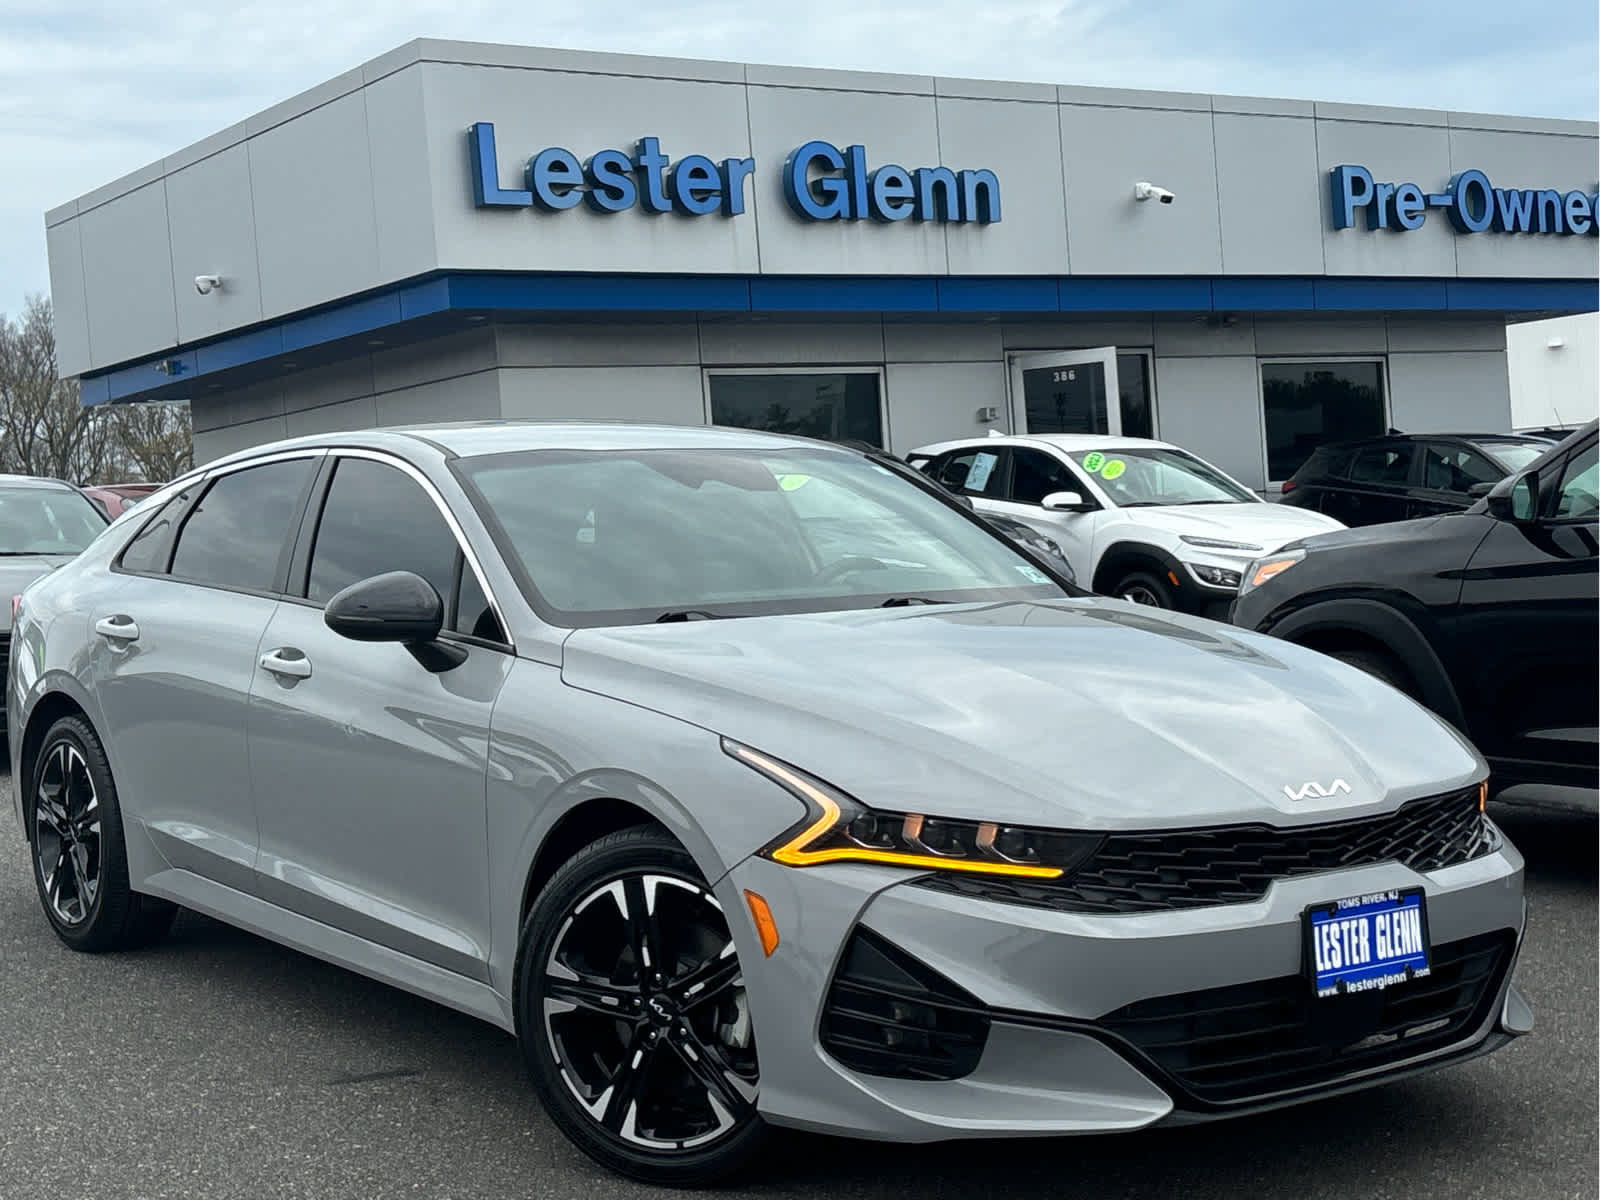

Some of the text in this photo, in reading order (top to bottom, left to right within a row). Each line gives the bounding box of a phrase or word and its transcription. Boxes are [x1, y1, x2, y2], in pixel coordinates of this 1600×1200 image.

[468, 122, 1002, 225] Lester Glenn
[1338, 898, 1361, 910] TOMS
[1388, 890, 1399, 900] NJ
[1314, 909, 1422, 972] LESTER GLENN
